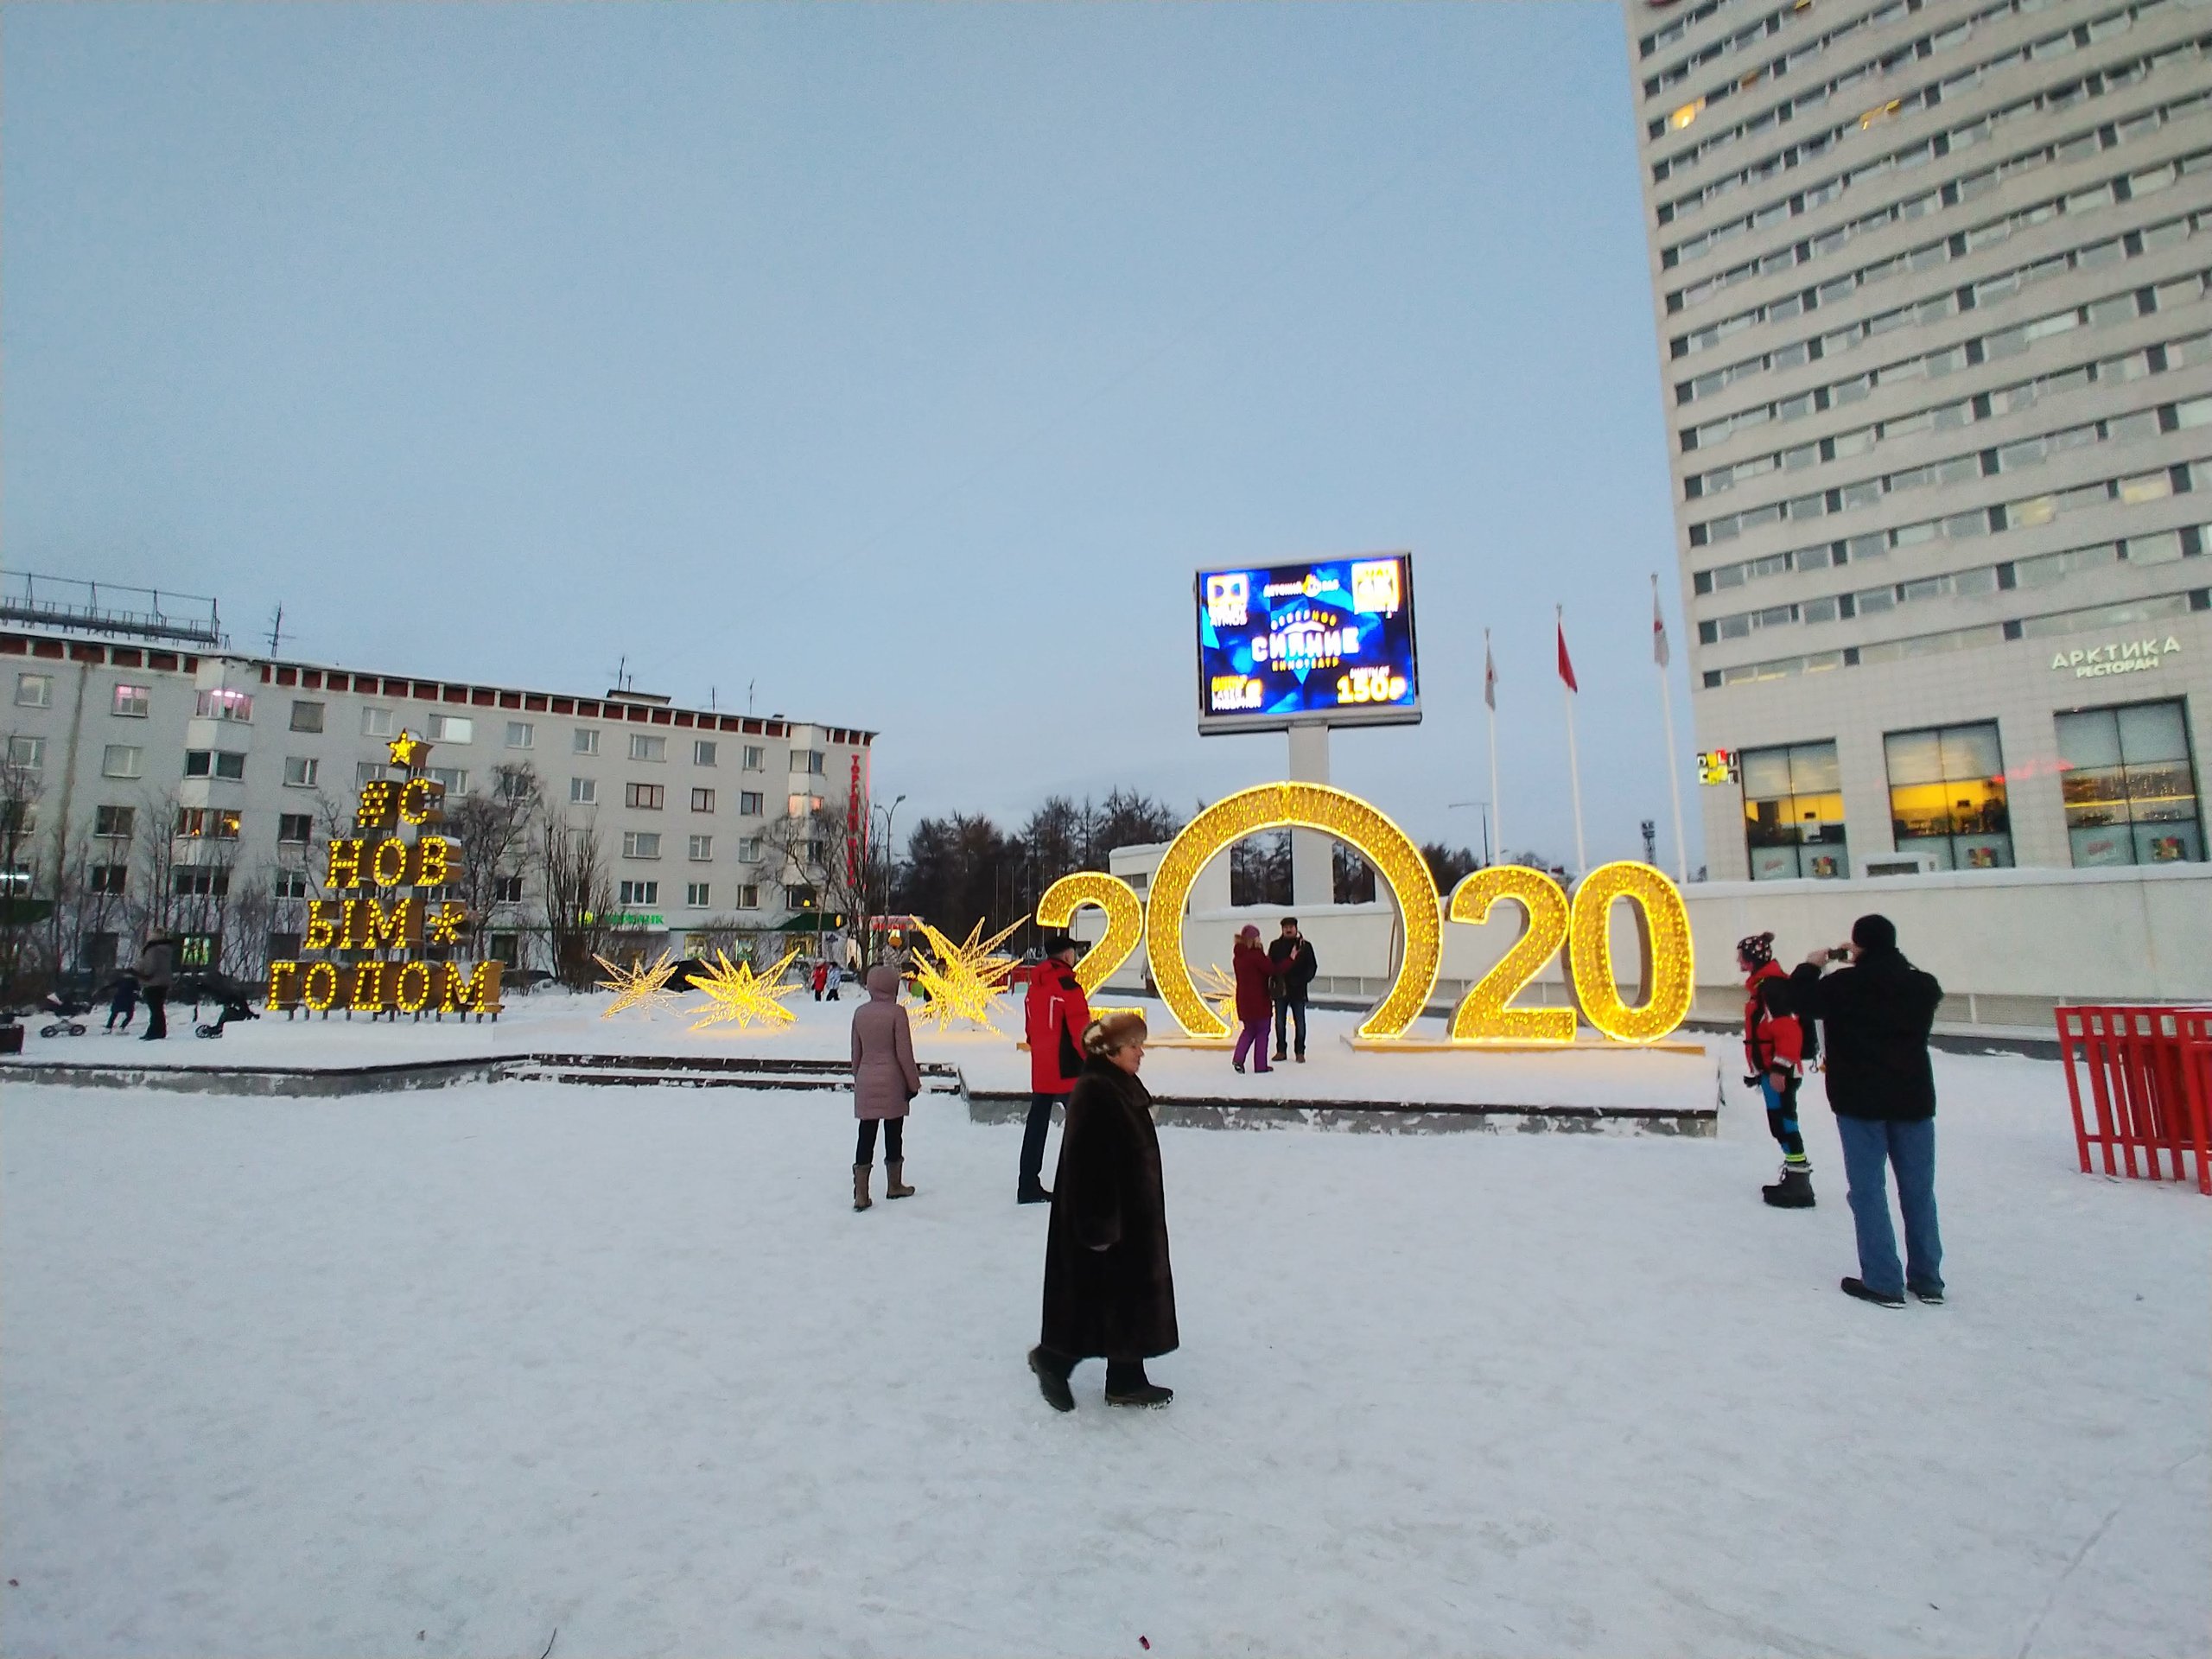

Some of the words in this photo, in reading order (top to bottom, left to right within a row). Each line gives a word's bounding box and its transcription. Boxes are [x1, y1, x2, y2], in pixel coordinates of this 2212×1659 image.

[2052, 636, 2181, 670] АРКТИКА
[2076, 656, 2159, 678] РЕСТОРАН
[324, 836, 448, 889] НОВ
[1035, 780, 1695, 1043] 2020
[265, 960, 489, 1014] ГОДОМ
